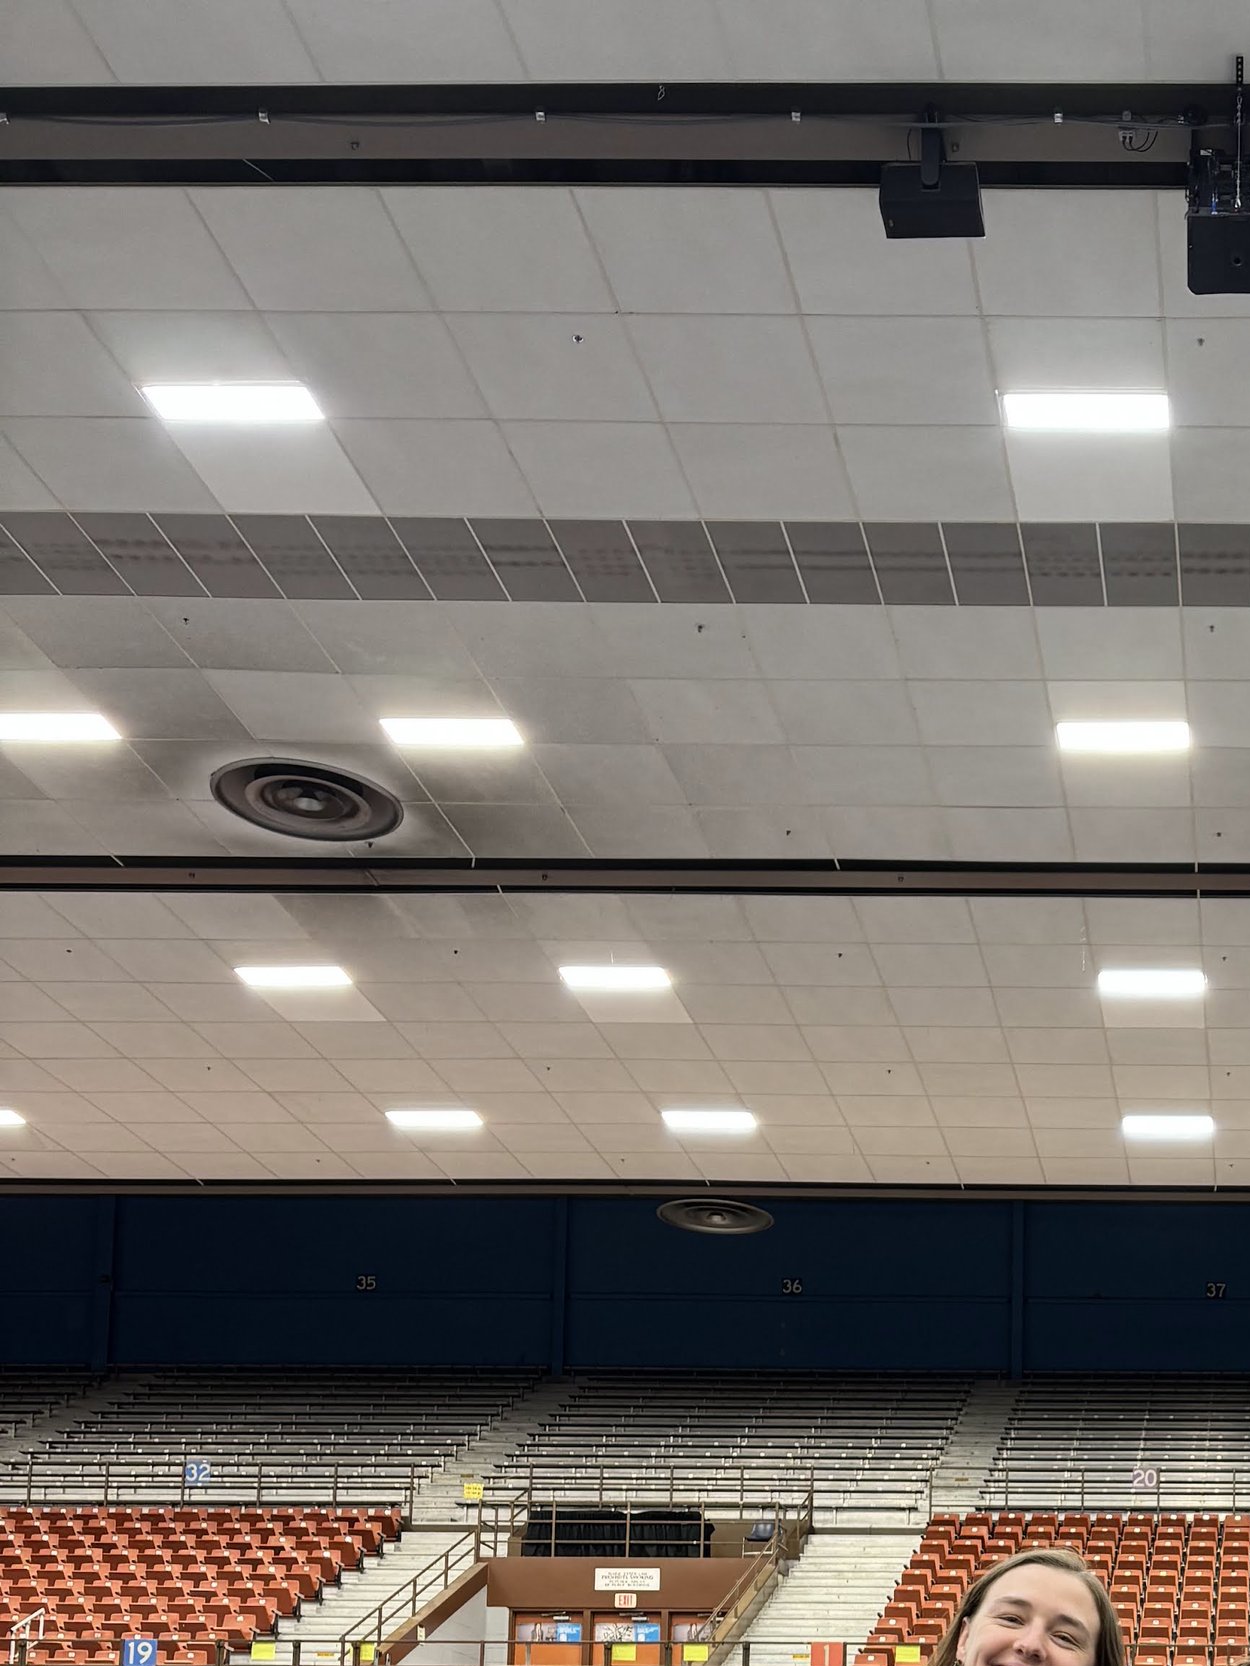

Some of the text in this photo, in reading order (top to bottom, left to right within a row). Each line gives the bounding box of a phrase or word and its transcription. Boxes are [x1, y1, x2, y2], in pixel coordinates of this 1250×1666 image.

[356, 1275, 376, 1290] 35
[783, 1279, 802, 1293] 36
[1206, 1283, 1226, 1297] 37
[186, 1463, 210, 1482] 32
[1132, 1469, 1157, 1487] 20
[619, 1595, 633, 1606] EXIT
[128, 1641, 153, 1665] 19
